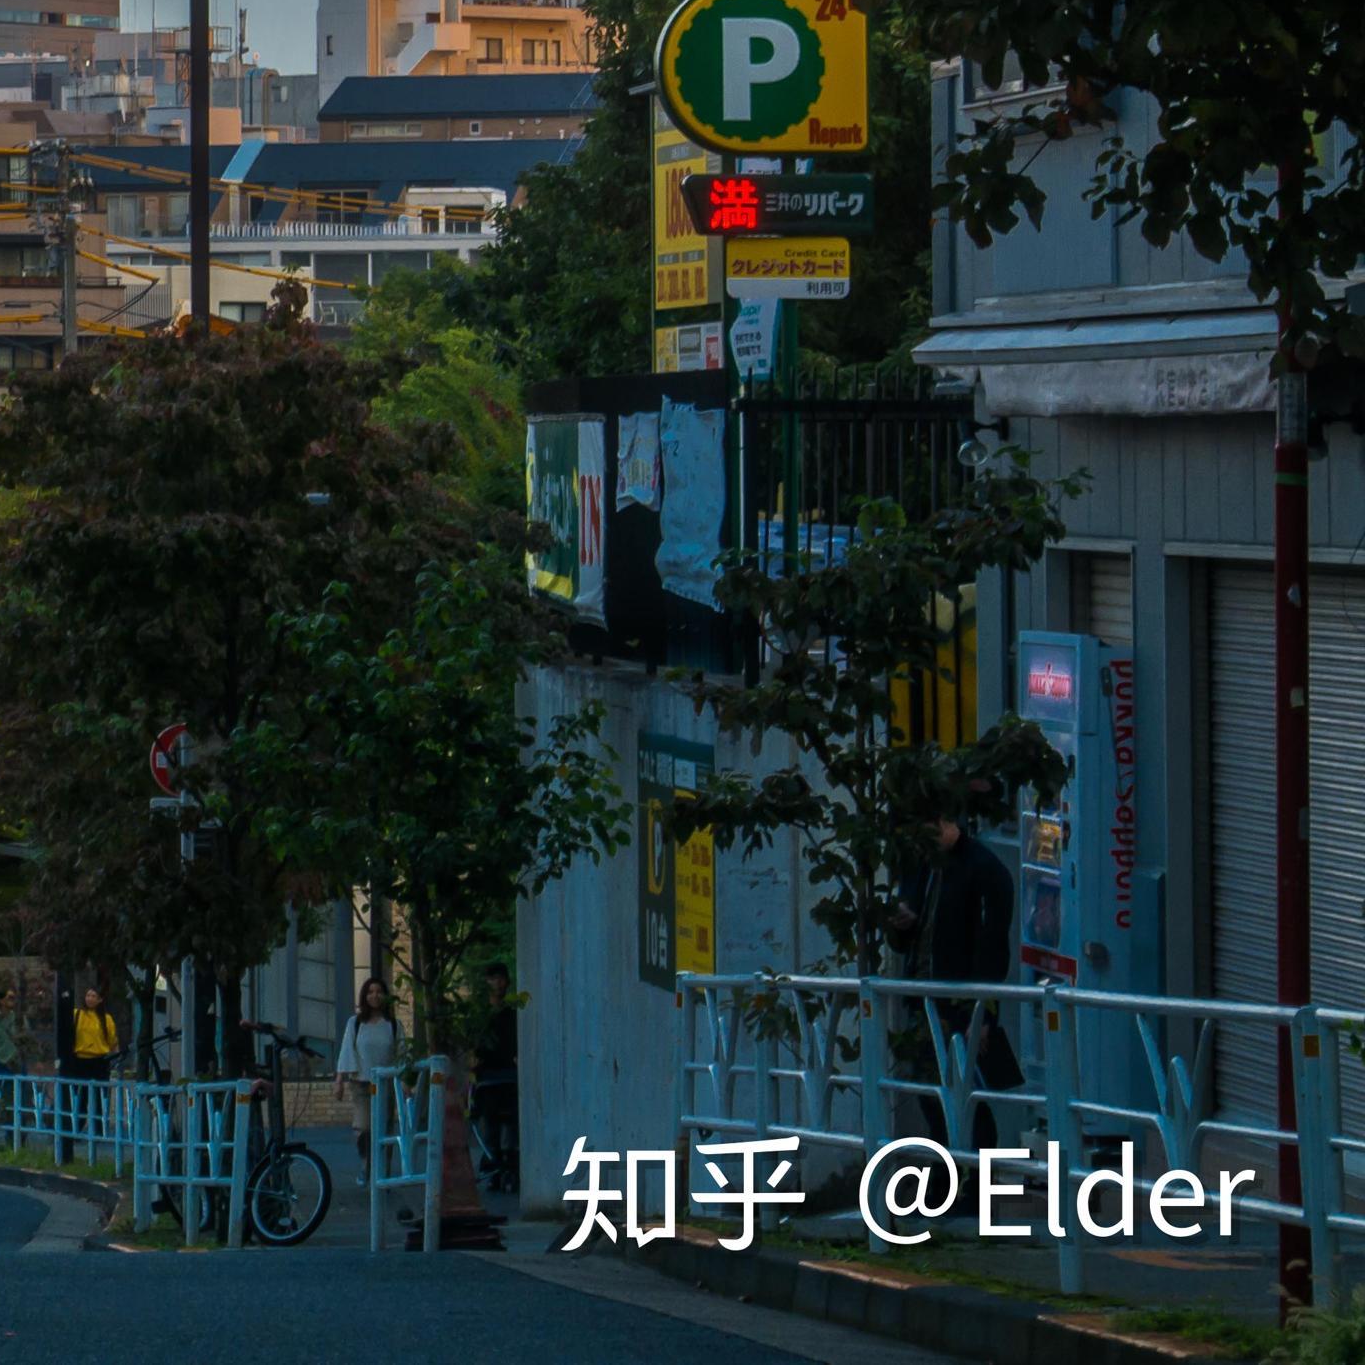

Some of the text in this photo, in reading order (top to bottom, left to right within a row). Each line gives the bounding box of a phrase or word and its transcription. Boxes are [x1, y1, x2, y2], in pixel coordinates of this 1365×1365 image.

[721, 17, 800, 121] P
[809, 119, 863, 148] Repark
[709, 178, 759, 230] 満
[784, 249, 846, 258] Credit Card
[731, 259, 846, 276] クレジットカード
[806, 281, 846, 295] 利用可
